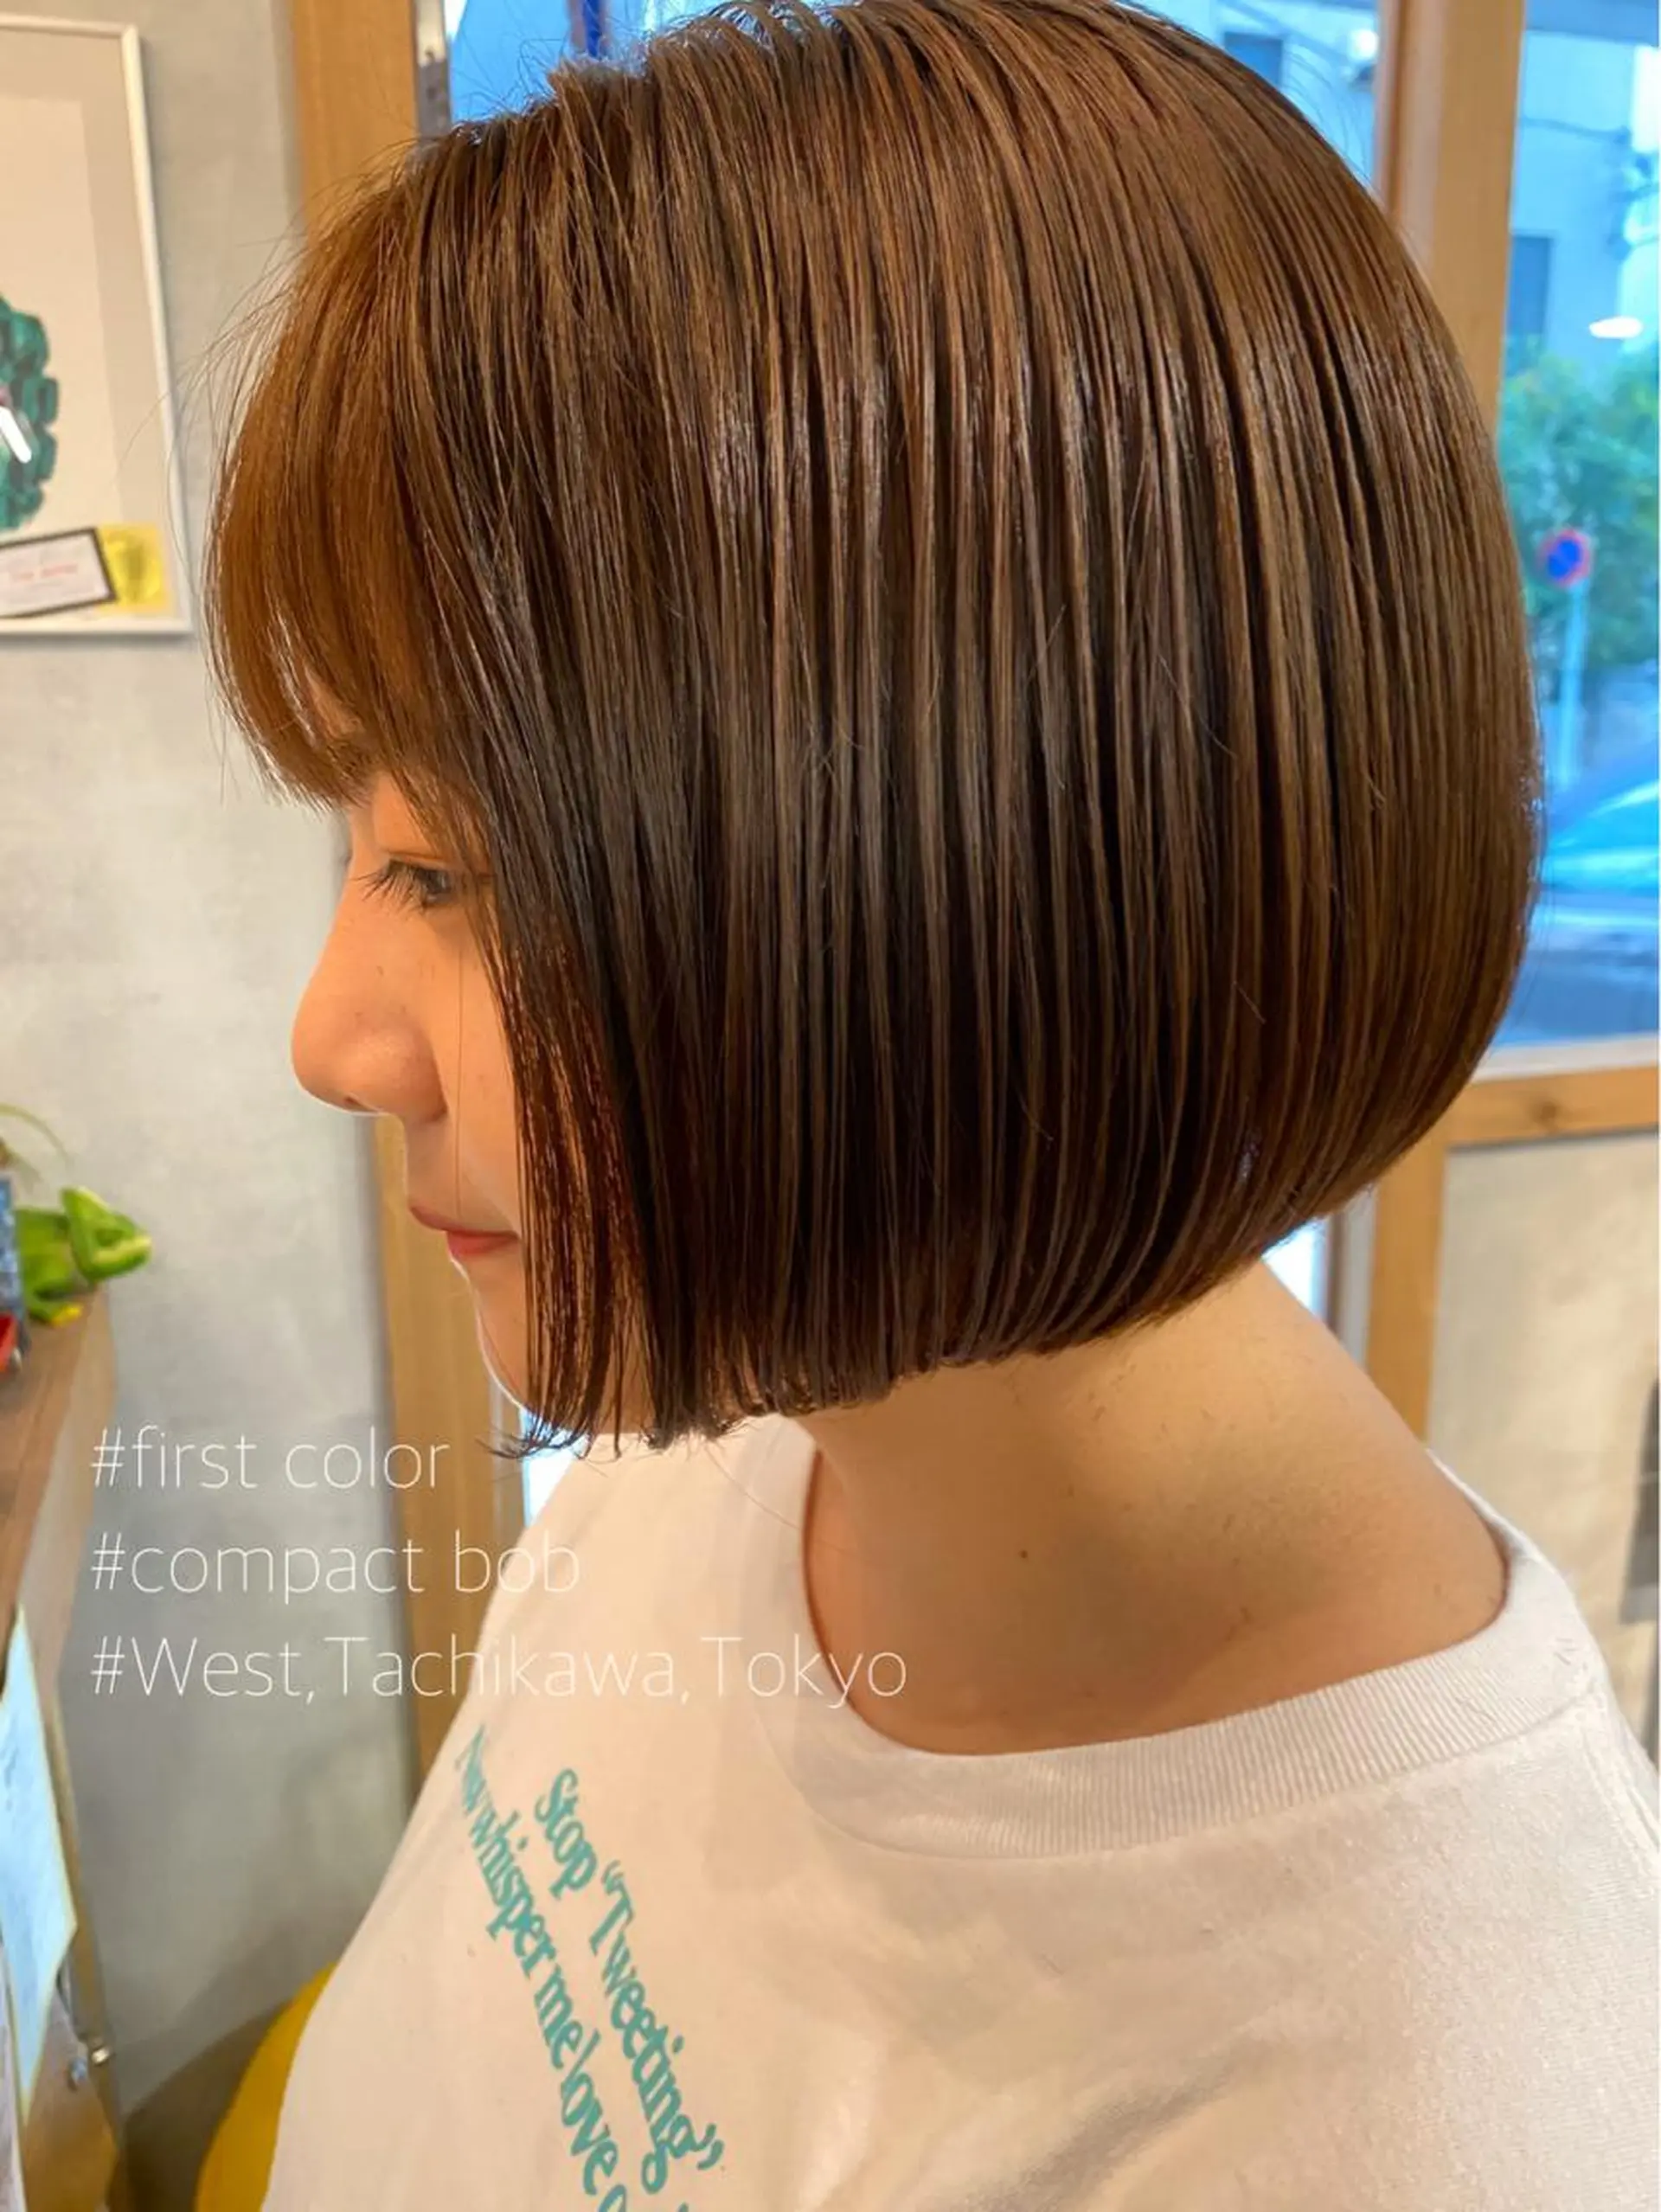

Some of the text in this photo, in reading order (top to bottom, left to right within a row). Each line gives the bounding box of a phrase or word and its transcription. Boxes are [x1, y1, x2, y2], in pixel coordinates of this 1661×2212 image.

[535, 1767, 598, 1901] Stop
[468, 1789, 557, 1981] whisper
[533, 1962, 584, 2070] me
[560, 2028, 619, 2197] love
